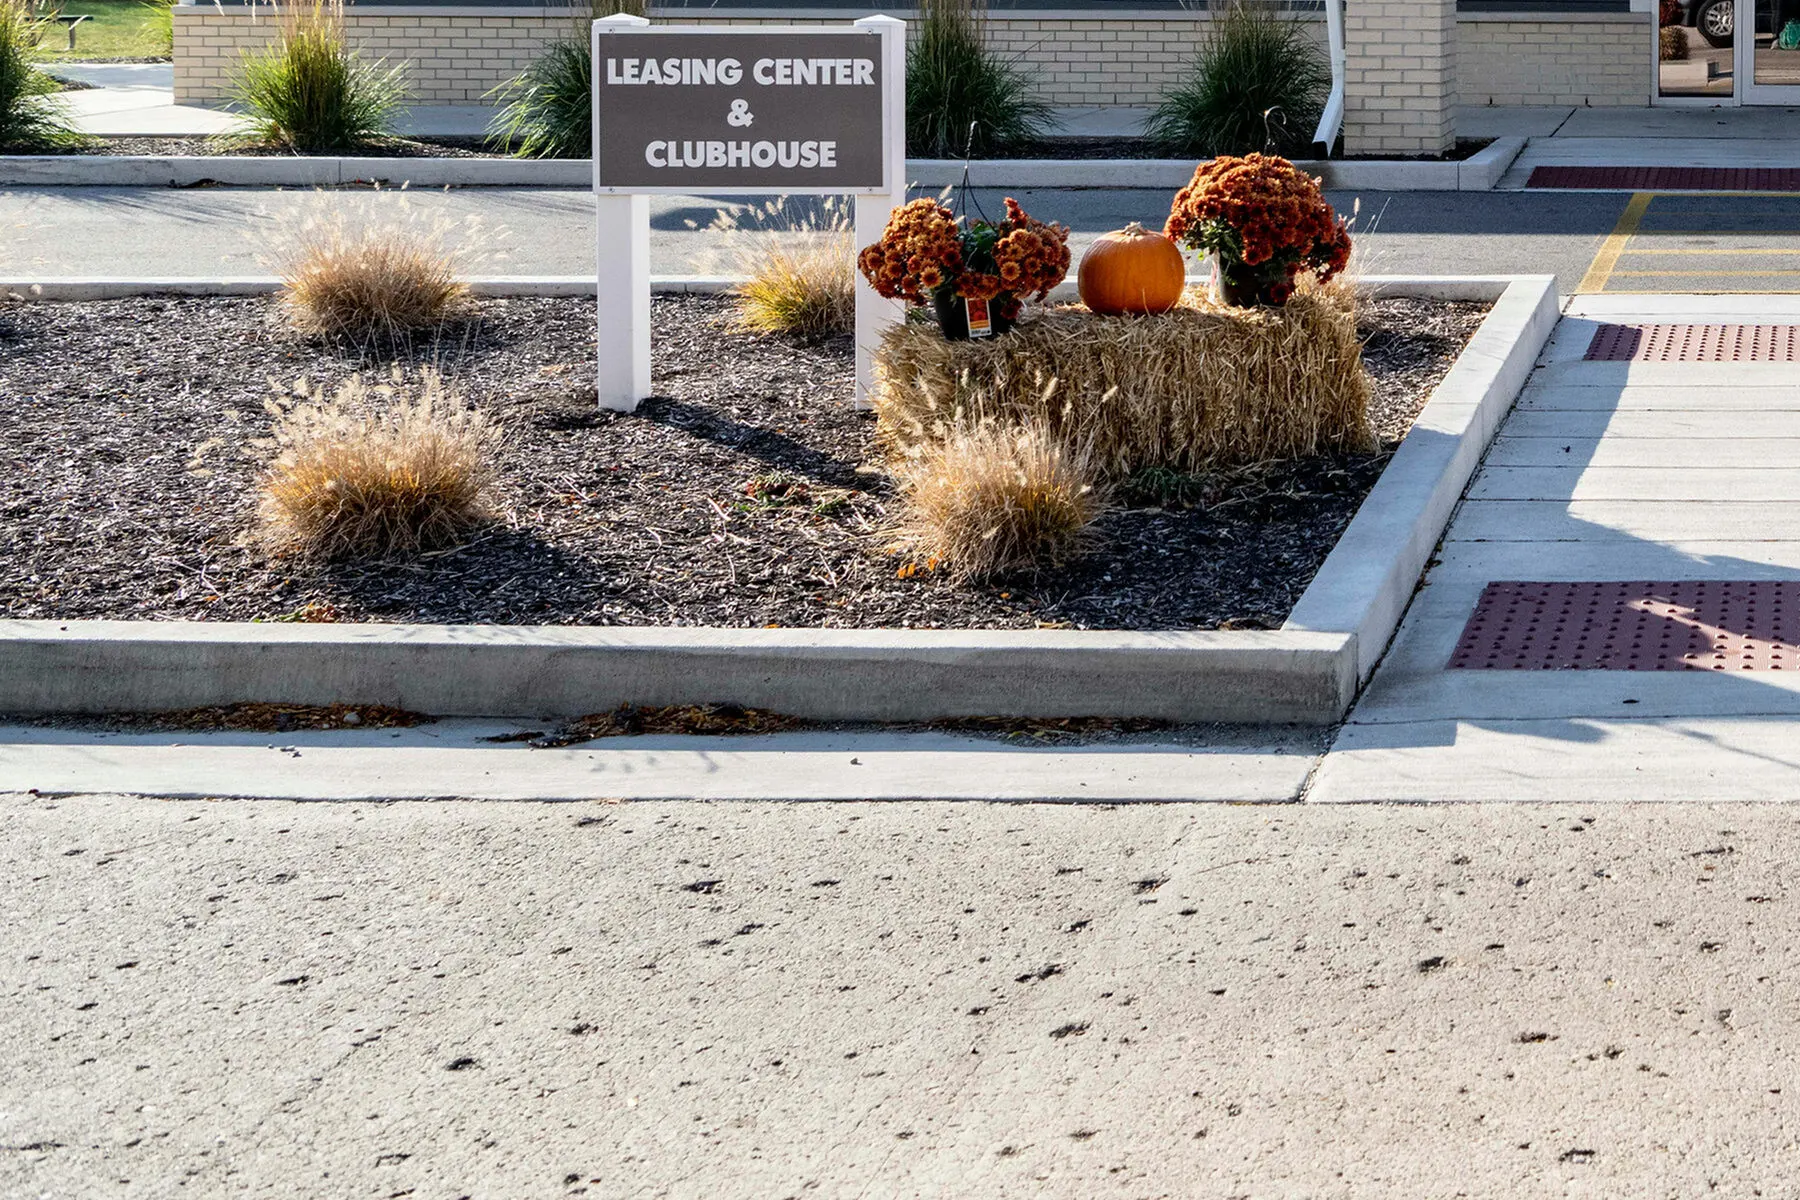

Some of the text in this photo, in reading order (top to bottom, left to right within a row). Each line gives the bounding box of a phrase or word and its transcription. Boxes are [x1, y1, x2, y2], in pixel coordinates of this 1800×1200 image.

[607, 57, 875, 86] LEASING CENTER
[726, 98, 754, 128] &
[645, 140, 837, 169] CLUBHOUSE
